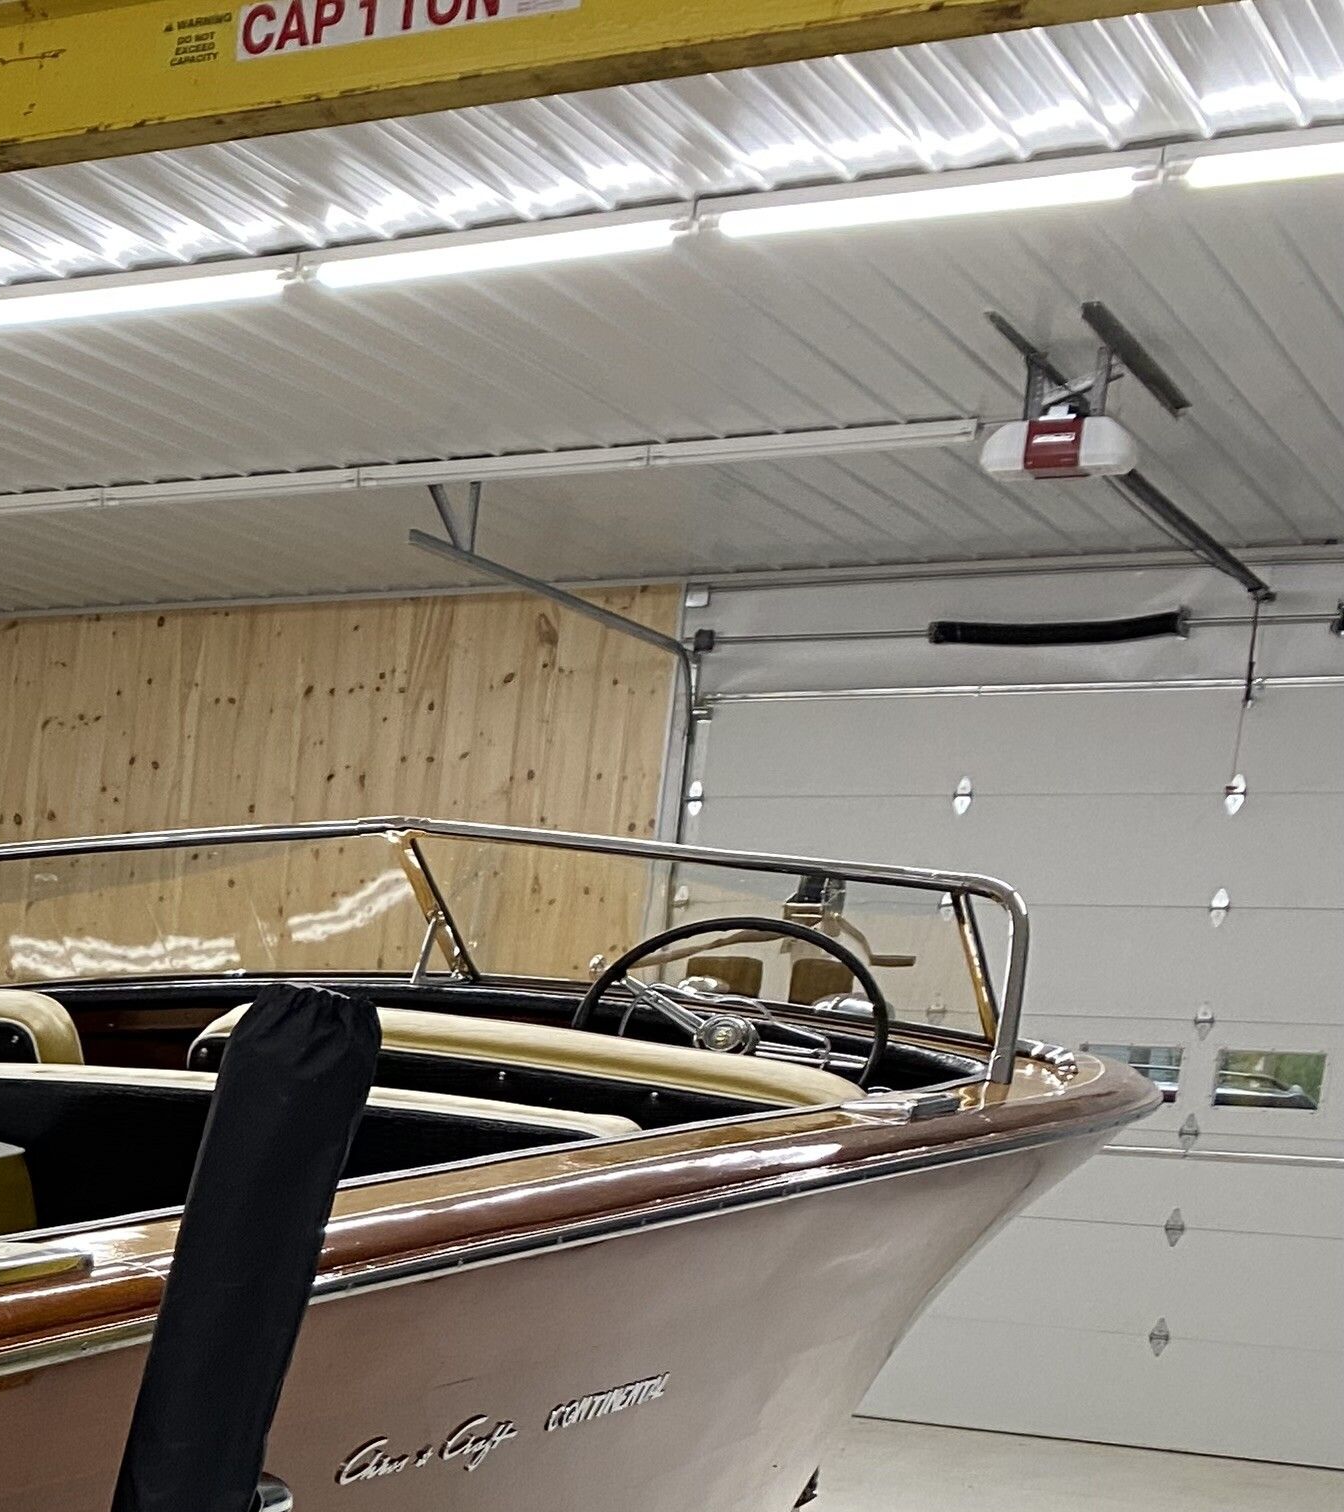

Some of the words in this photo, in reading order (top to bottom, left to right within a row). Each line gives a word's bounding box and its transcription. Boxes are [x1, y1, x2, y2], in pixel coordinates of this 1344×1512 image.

[176, 12, 232, 30] WARNING
[242, 0, 346, 55] CAP
[359, 0, 377, 36] 1
[175, 41, 216, 56] EXCEED
[177, 35, 192, 46] DO
[170, 51, 219, 67] CAPACITY
